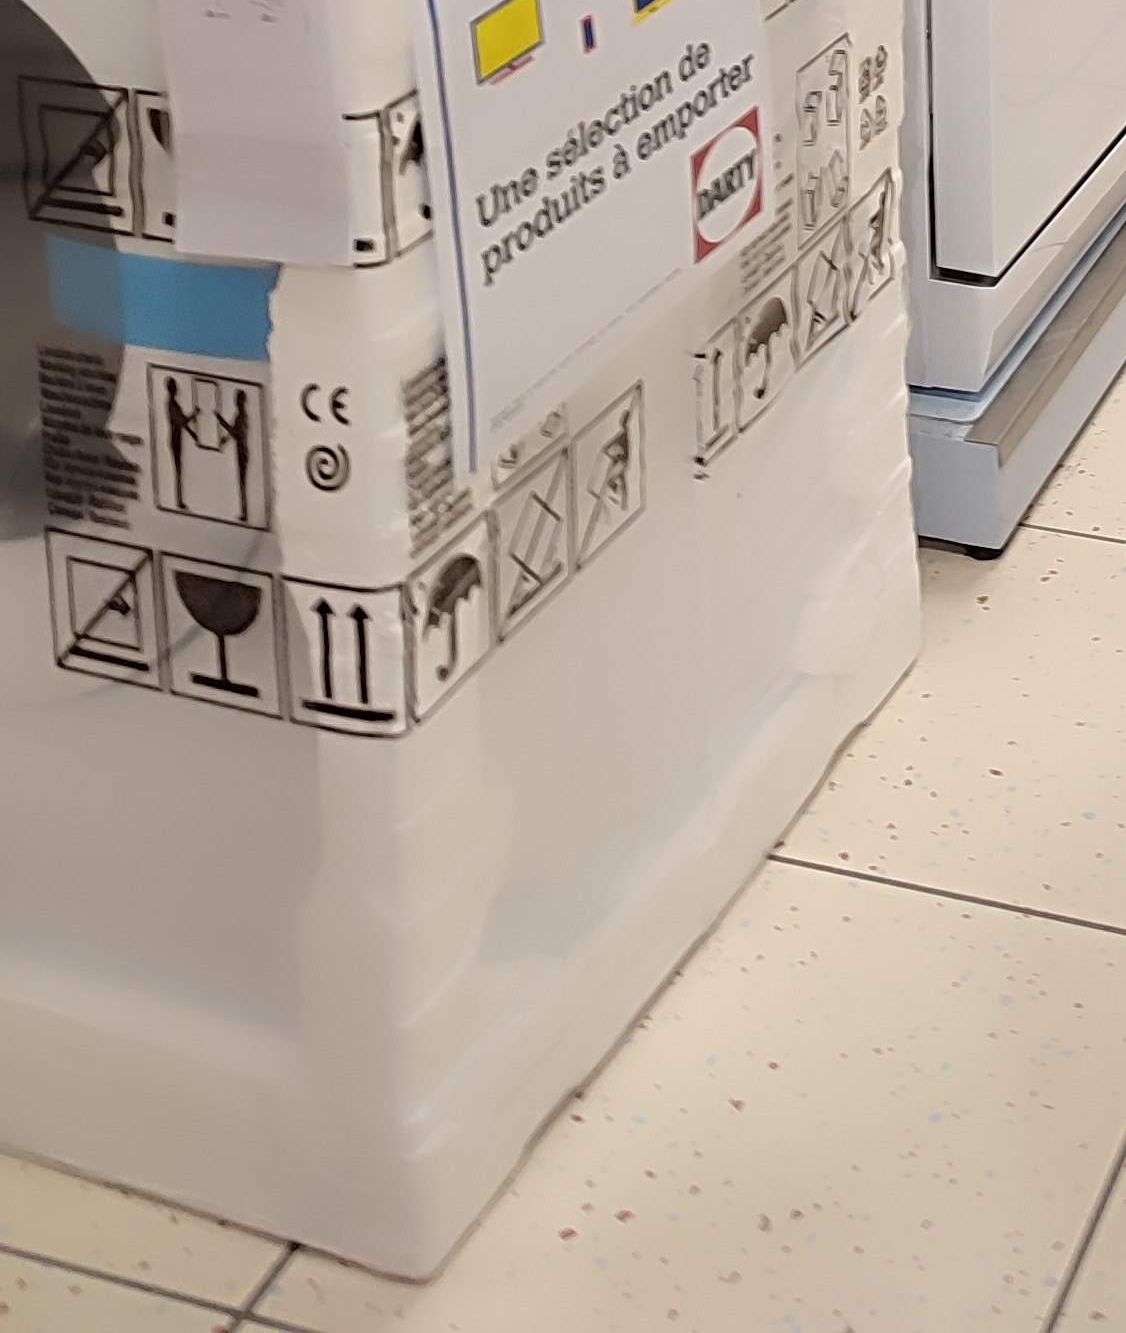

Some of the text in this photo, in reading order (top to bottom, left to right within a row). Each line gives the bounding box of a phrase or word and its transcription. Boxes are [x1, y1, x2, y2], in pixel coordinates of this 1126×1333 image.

[475, 42, 712, 227] Une sélection de
[480, 165, 607, 287] produits
[612, 143, 631, 179] à
[636, 53, 754, 160] emporter
[696, 148, 757, 221] DARTY
[301, 383, 350, 425] CE
